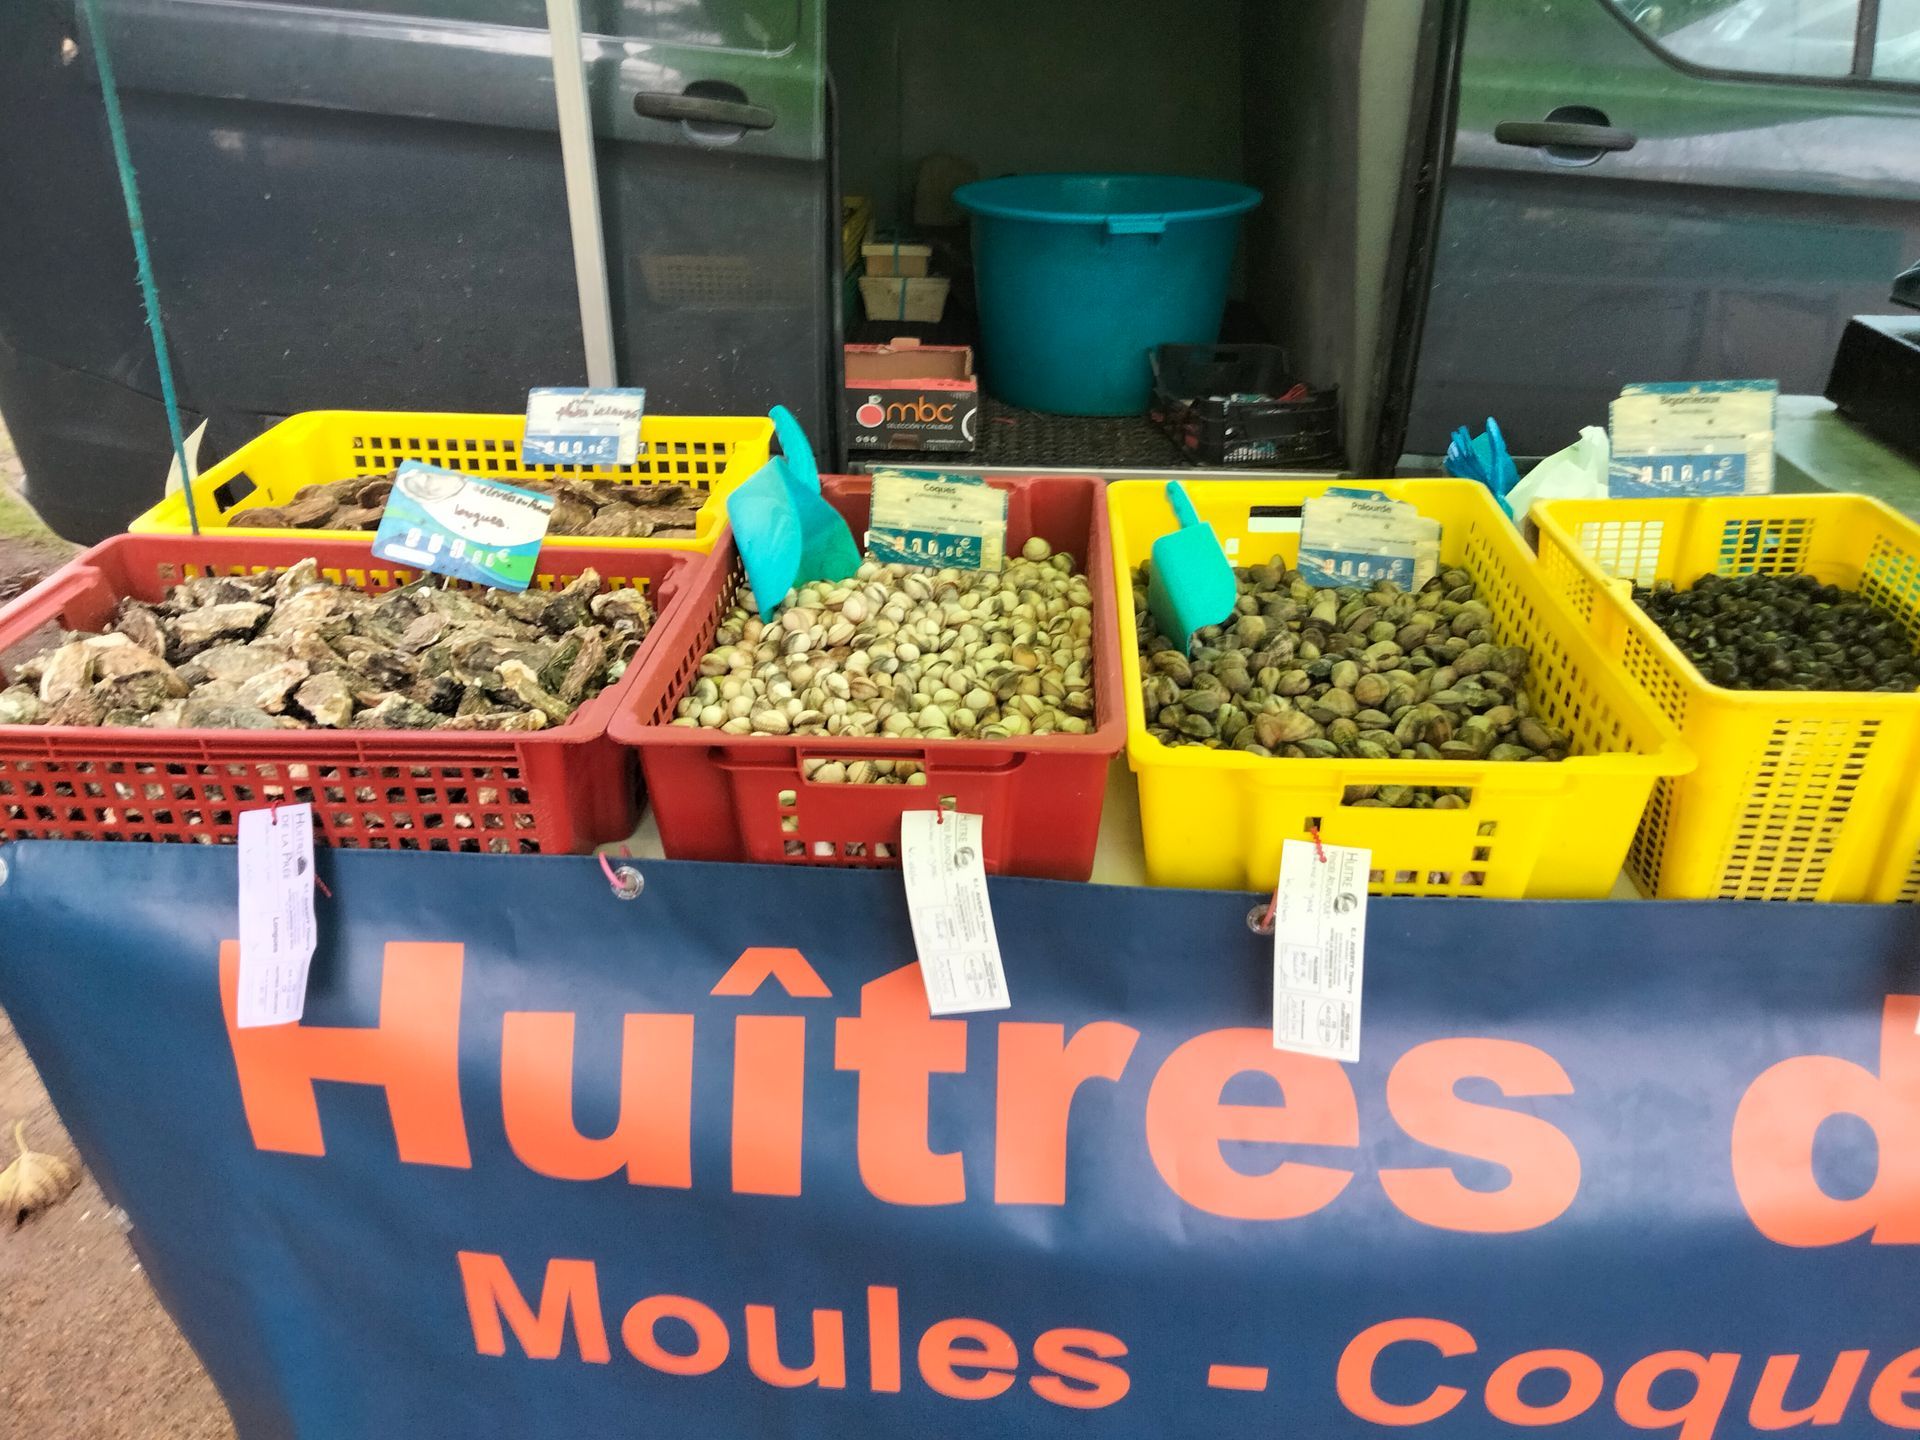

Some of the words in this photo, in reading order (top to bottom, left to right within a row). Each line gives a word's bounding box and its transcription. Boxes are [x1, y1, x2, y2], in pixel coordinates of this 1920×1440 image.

[886, 395, 957, 423] mbc
[923, 483, 957, 495] Coques
[1351, 501, 1392, 513] Palourde
[219, 940, 1582, 1234] Huîtres
[457, 1250, 1131, 1410] Moules
